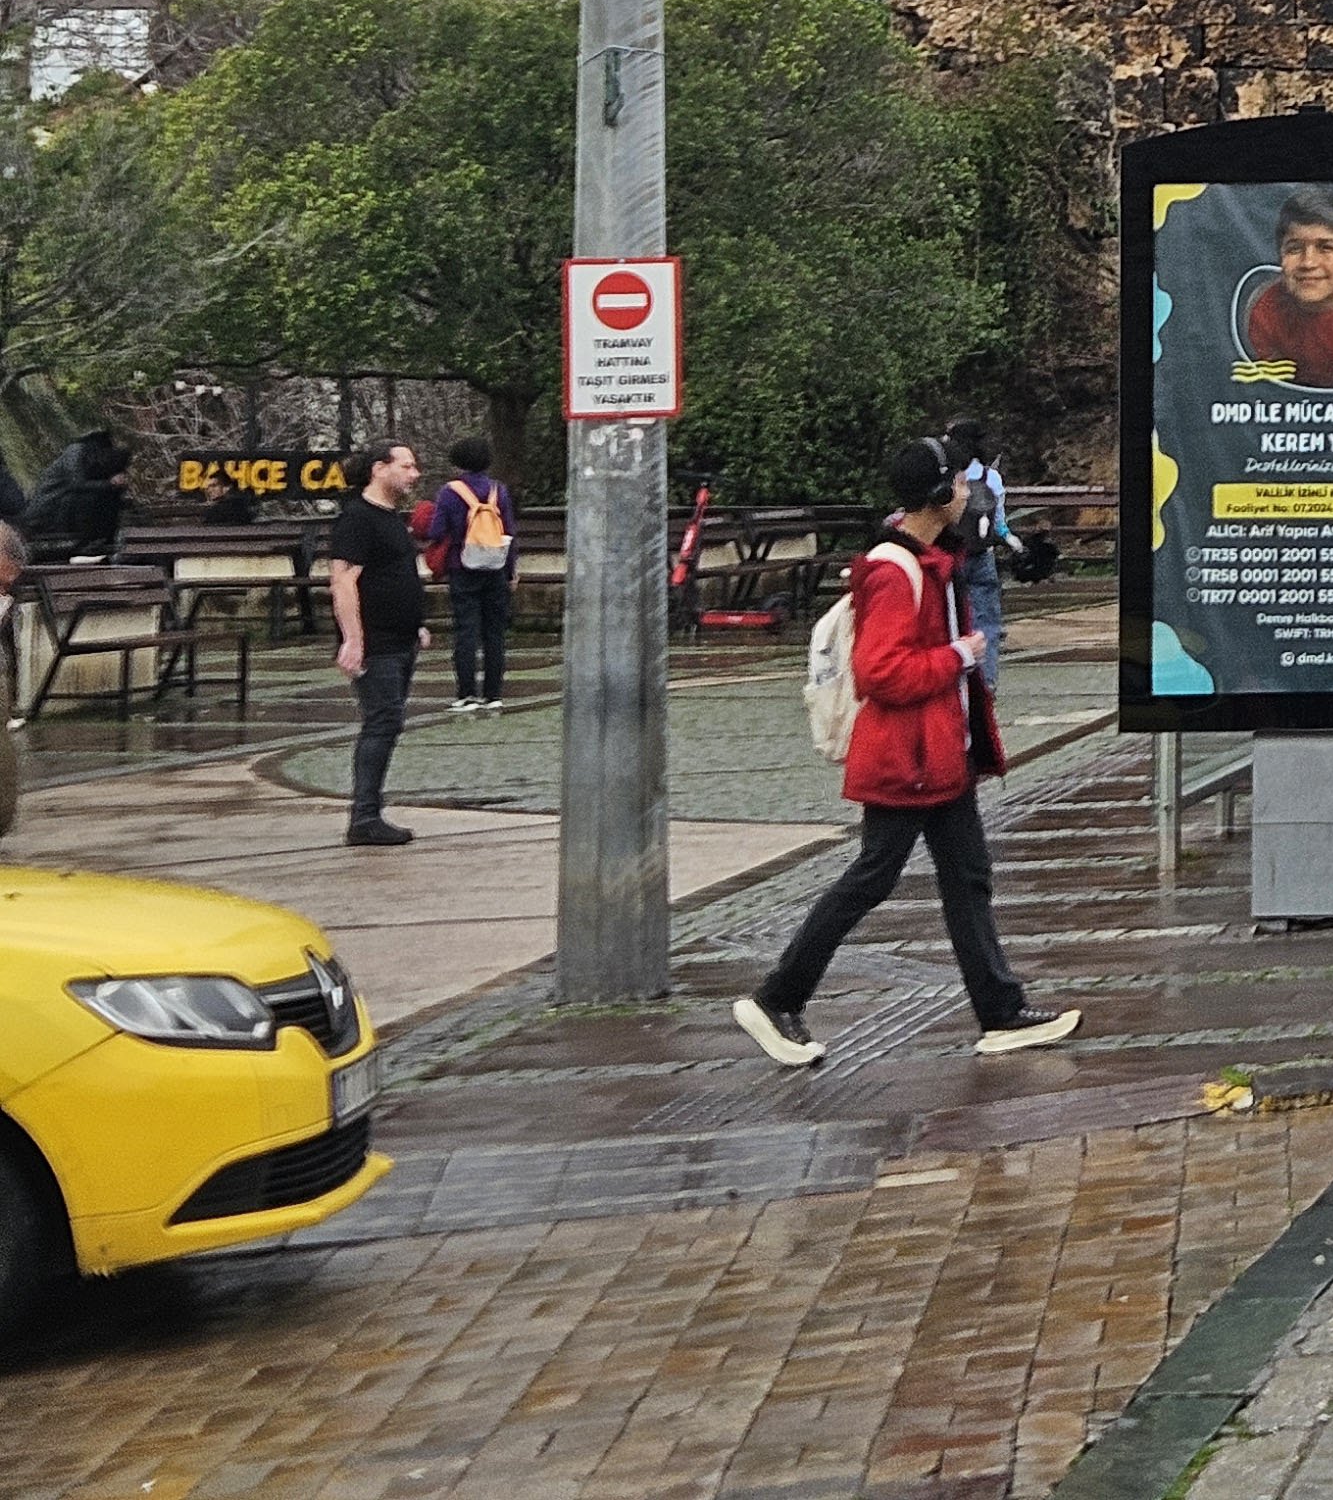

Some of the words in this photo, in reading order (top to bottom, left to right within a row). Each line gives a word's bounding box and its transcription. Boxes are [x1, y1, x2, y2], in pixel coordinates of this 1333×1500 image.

[593, 337, 654, 349] TRAMVAY
[596, 356, 652, 368] HATTINA
[577, 375, 614, 388] TAŞIT
[618, 372, 670, 385] GİRMESİ
[593, 393, 656, 405] YASAKTIR
[1211, 402, 1252, 423] DMD
[1254, 399, 1282, 423] İLE
[1261, 432, 1325, 453] KEREM
[1226, 503, 1269, 514] Faaliyet
[1249, 524, 1275, 538] Arif
[1276, 524, 1319, 540] Yapıcı
[1201, 547, 1238, 563] TR35
[1240, 547, 1278, 563] 0001
[1280, 547, 1317, 562] 2001
[1201, 568, 1239, 583] TR58
[1240, 568, 1279, 583] 0001
[1281, 568, 1318, 583] 2001
[1200, 589, 1237, 605] TR77
[1238, 589, 1277, 604] 0001
[1278, 589, 1315, 604] 2001
[1273, 627, 1312, 640] SWIFT:
